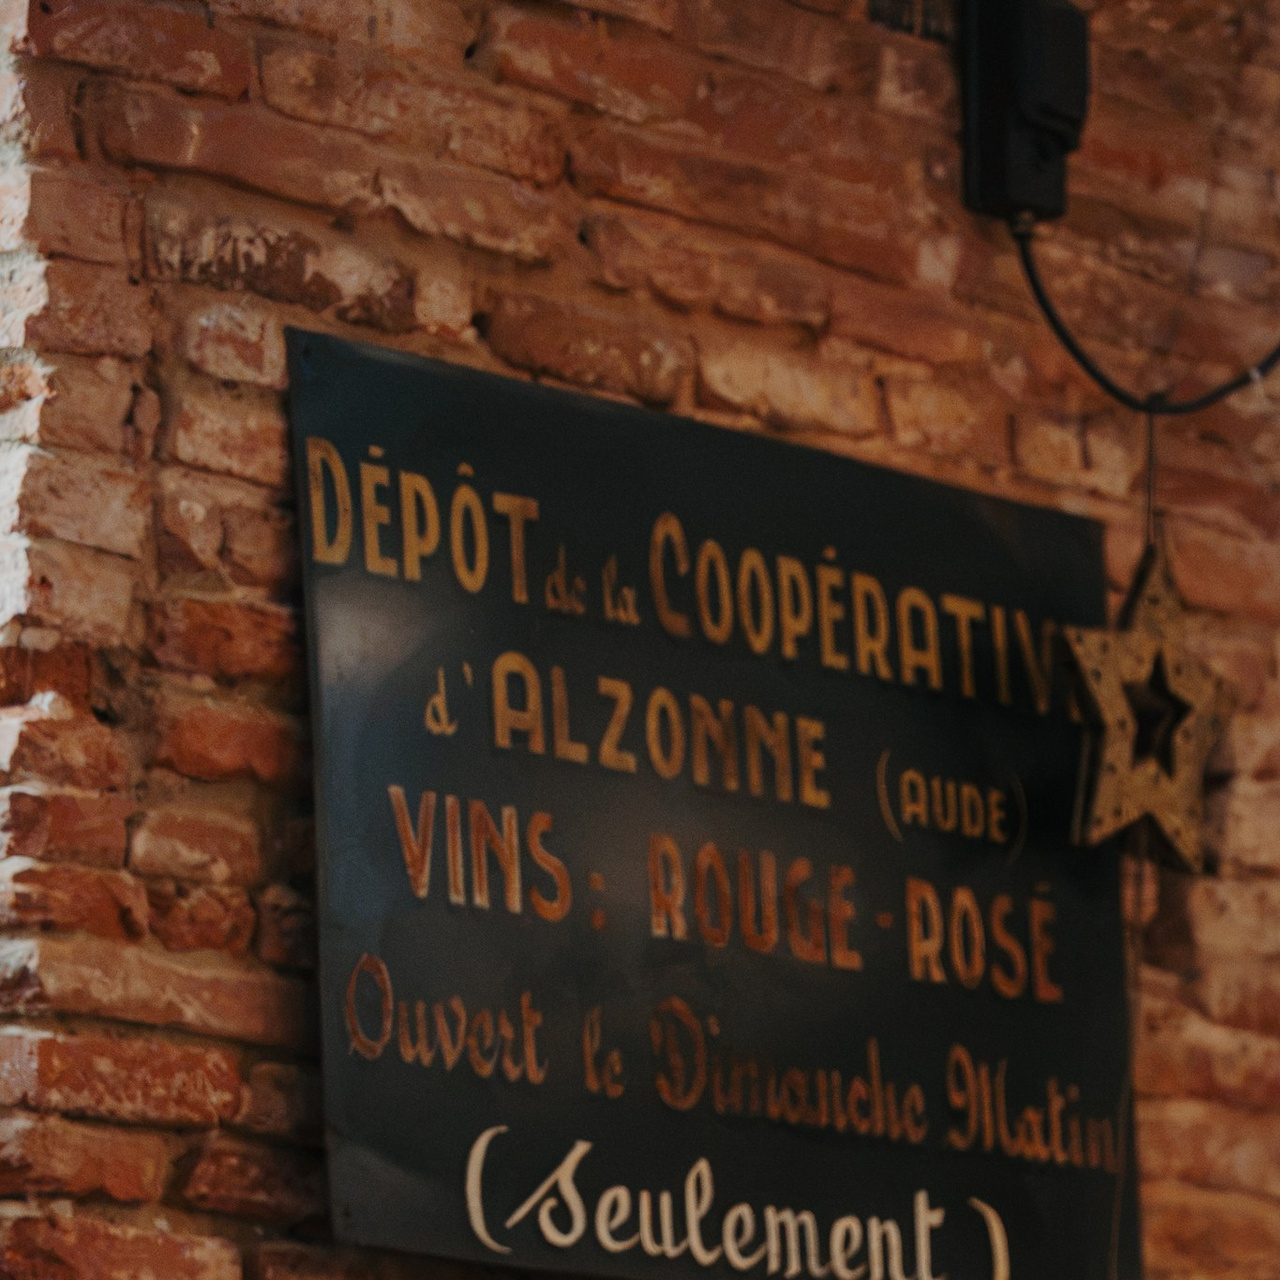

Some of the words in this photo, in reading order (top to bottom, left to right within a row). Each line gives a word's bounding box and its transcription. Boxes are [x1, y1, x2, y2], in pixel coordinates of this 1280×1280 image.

[306, 436, 540, 604] DÉPÔT
[545, 542, 586, 615] de
[602, 552, 640, 626] la
[649, 511, 1083, 725] COOPÉRATIV
[876, 748, 1029, 868] (AUDE)
[345, 952, 549, 1086] Ouvert
[583, 1006, 625, 1099] le
[650, 994, 929, 1144] Dimanche
[945, 1040, 1119, 1174] Matin
